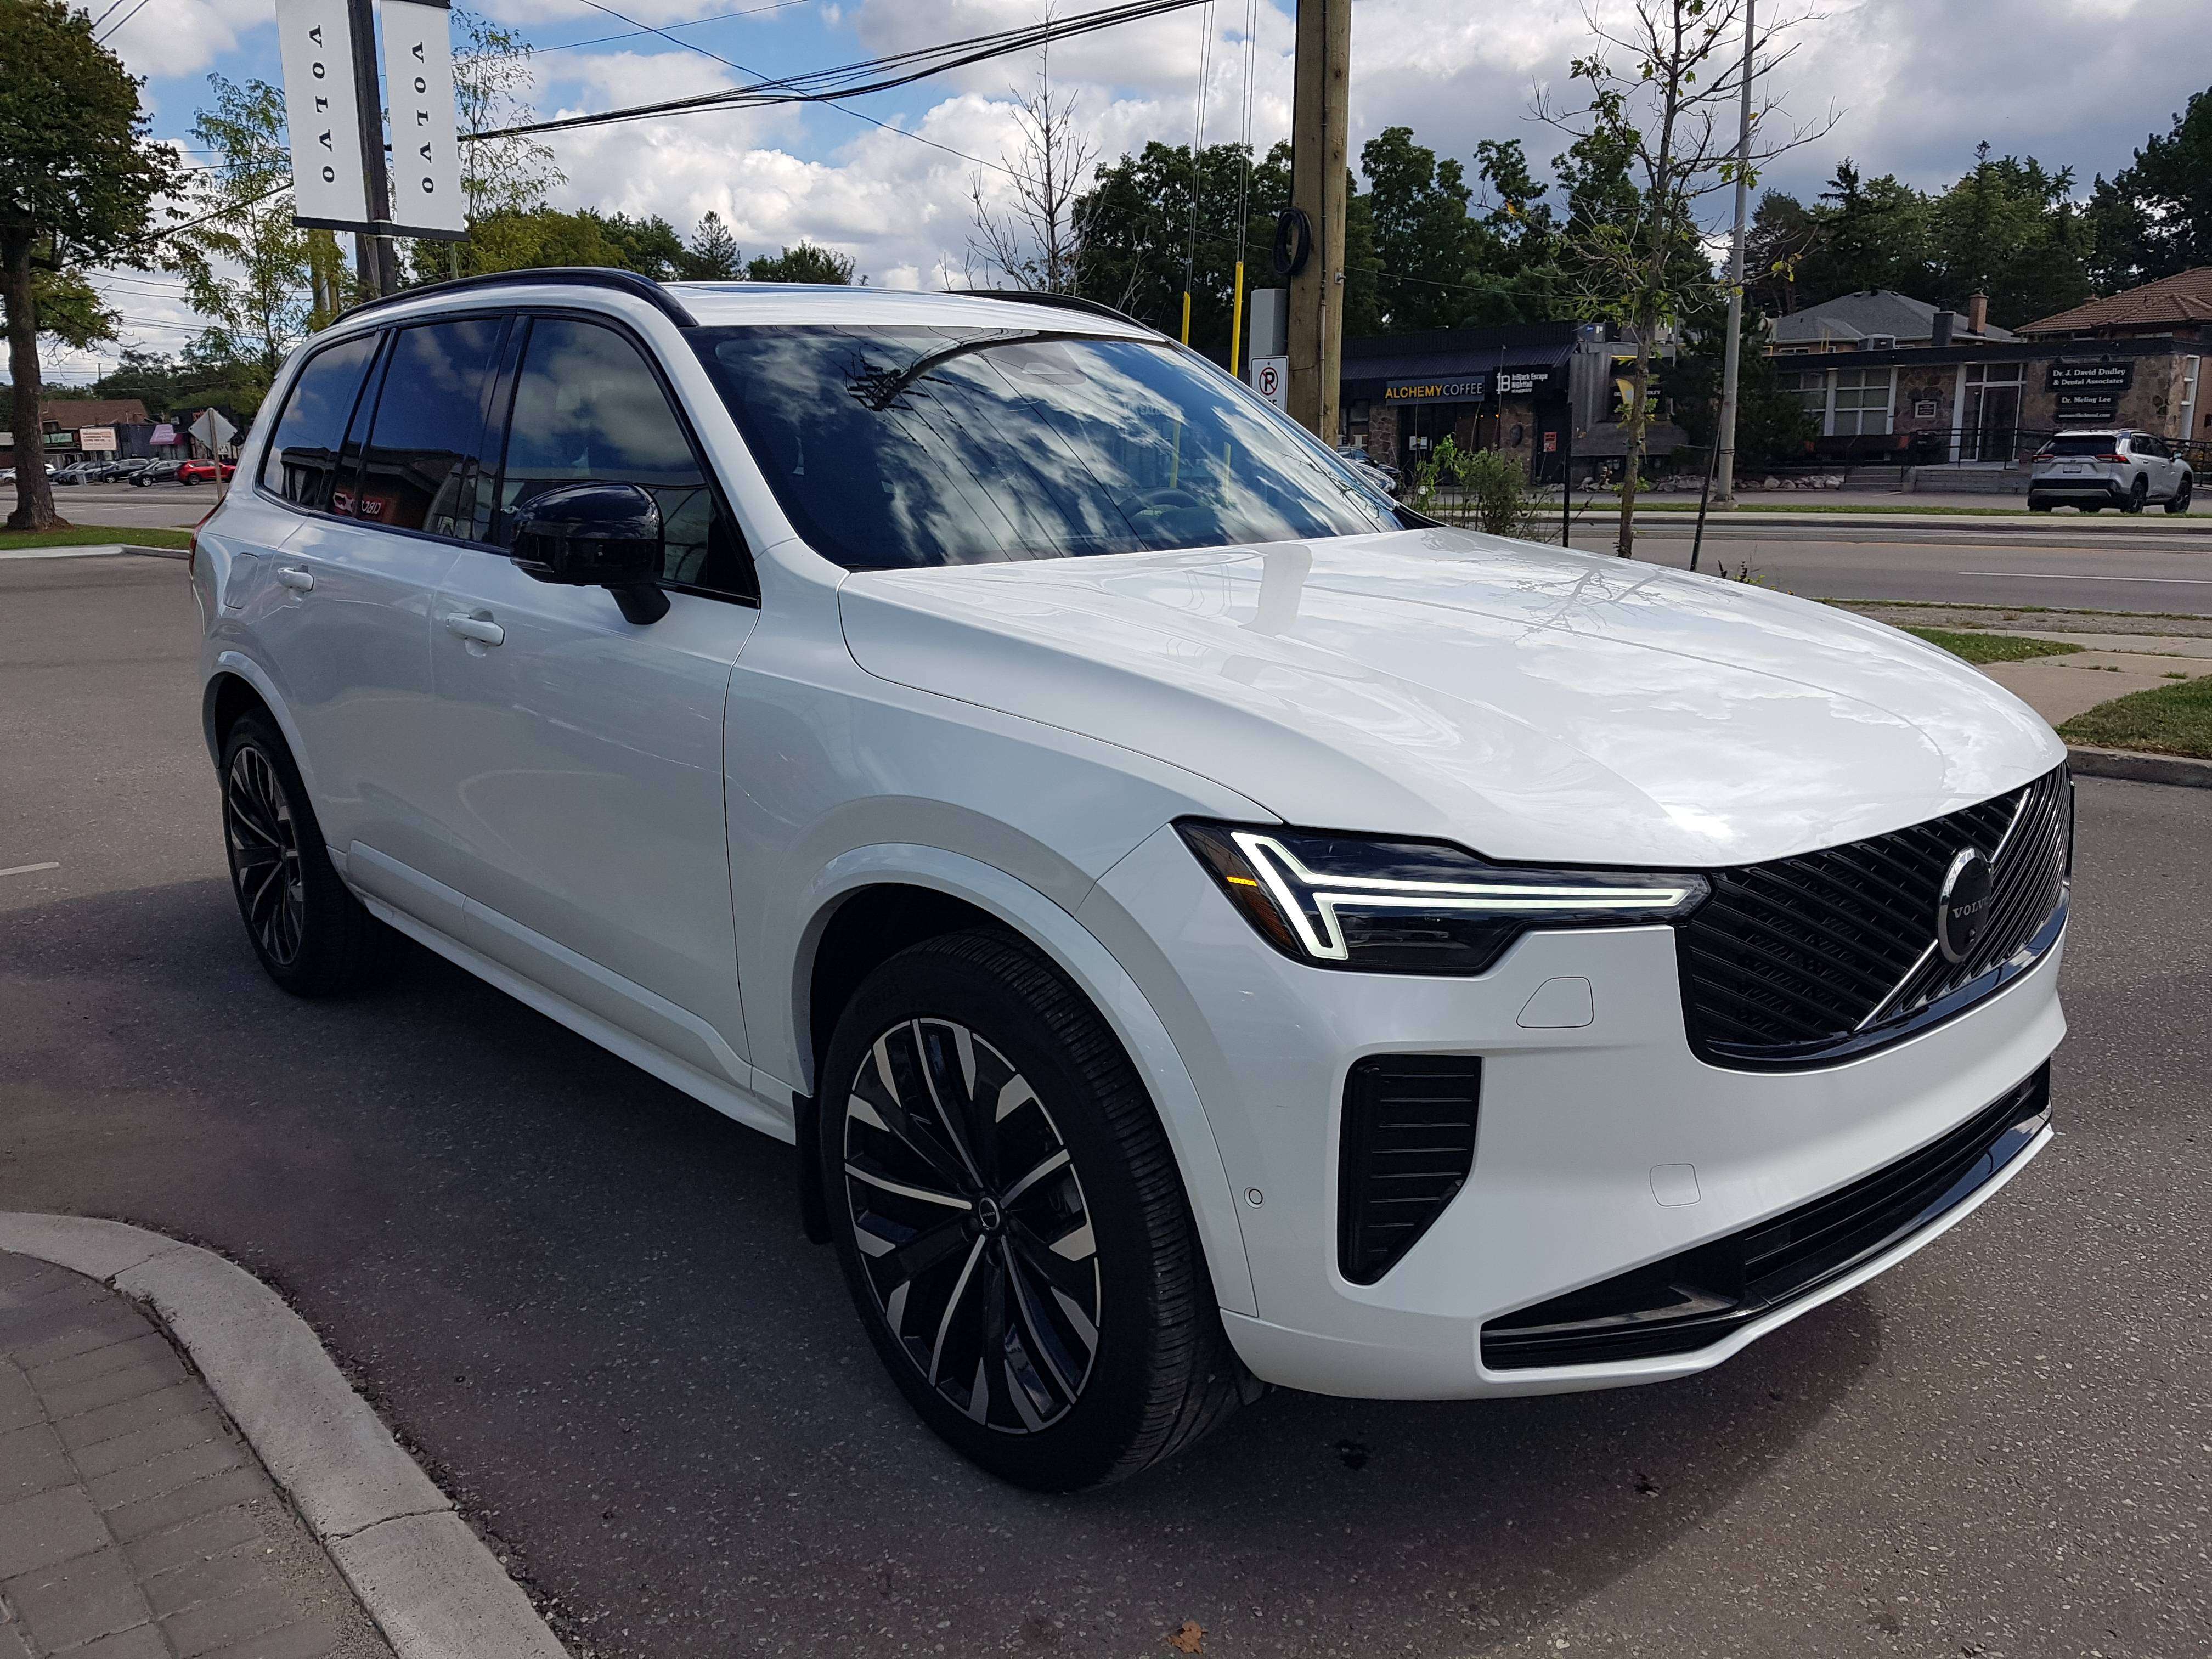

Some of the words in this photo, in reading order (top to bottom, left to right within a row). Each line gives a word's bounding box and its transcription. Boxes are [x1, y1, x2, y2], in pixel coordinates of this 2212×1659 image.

[309, 24, 335, 183] VOLVO
[411, 41, 435, 194] VOLVO
[2098, 368, 2126, 376] Dudley
